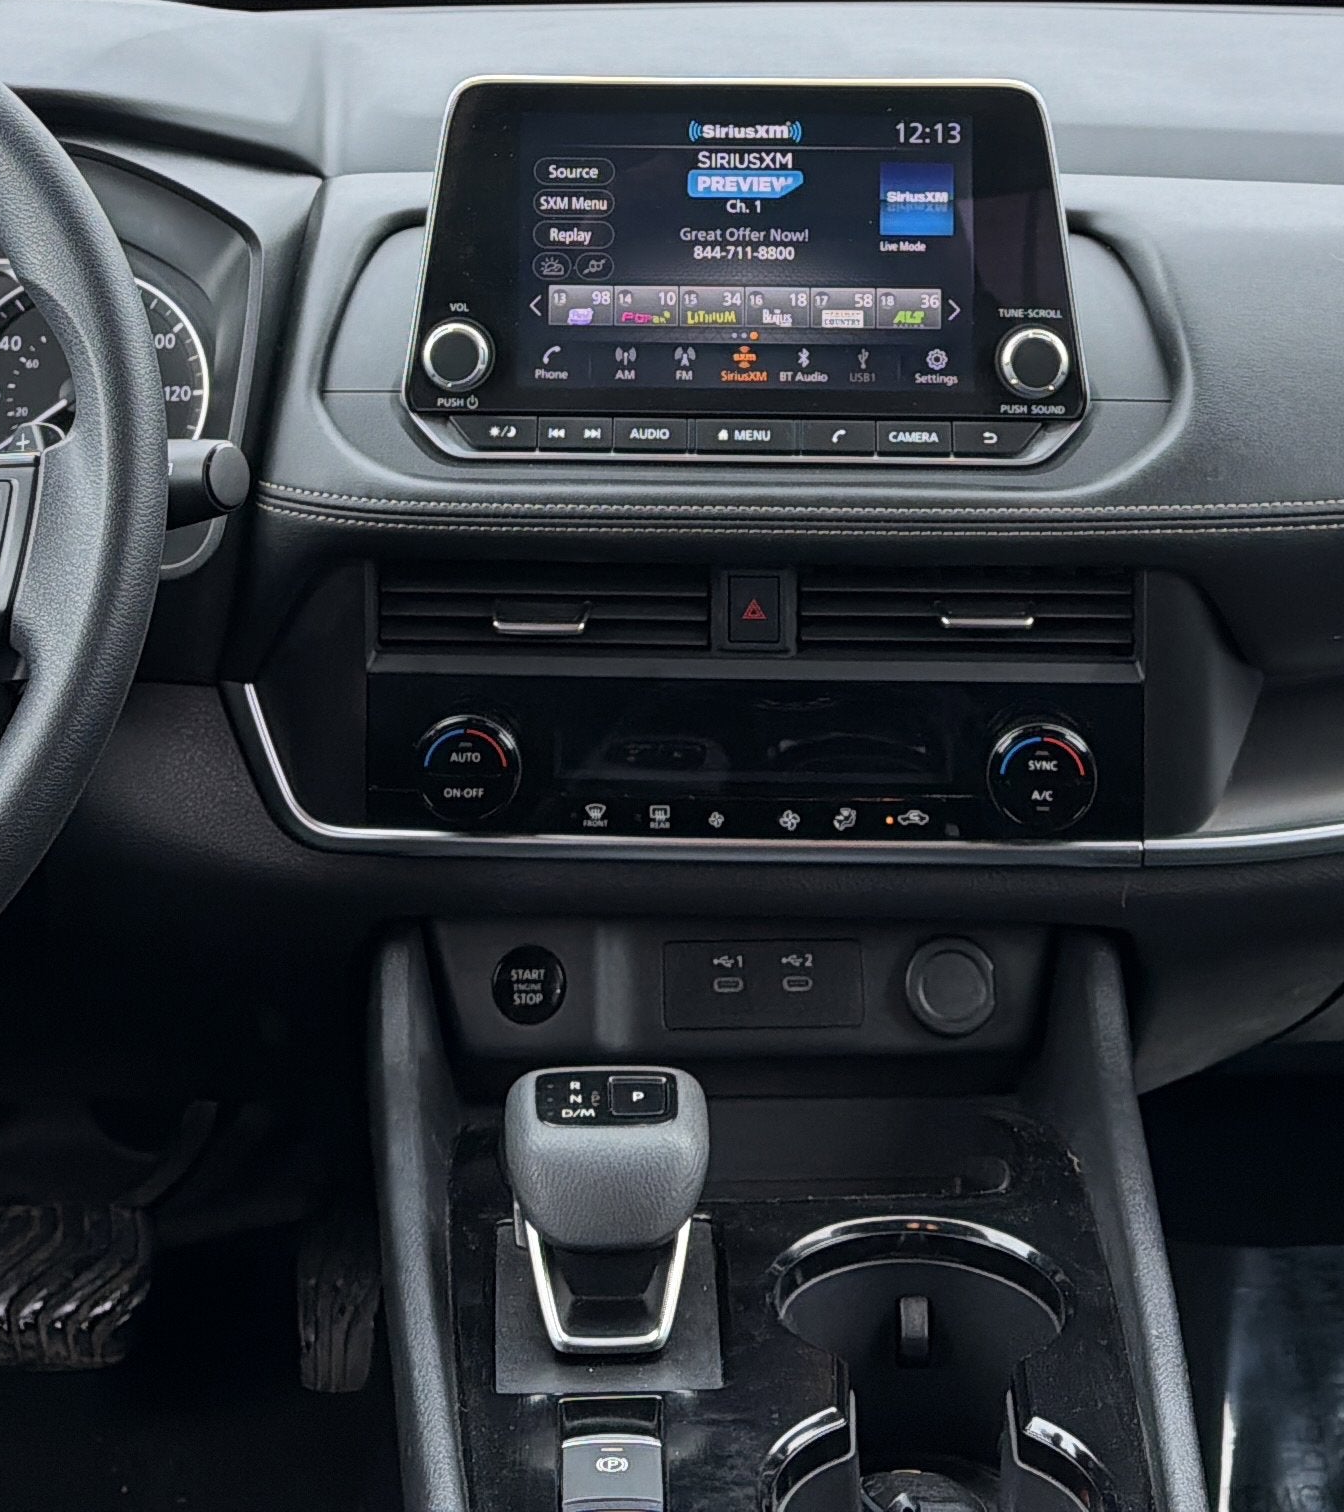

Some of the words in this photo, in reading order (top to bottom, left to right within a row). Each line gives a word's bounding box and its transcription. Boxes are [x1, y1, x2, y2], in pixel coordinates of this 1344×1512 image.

[895, 122, 961, 144] 12:13
[697, 151, 793, 169] SIRIUSXM
[548, 164, 599, 179] Source
[697, 176, 793, 192] PREVIEW
[540, 196, 568, 210] SXM
[571, 196, 608, 211] Menu
[726, 200, 750, 214] Ch.
[755, 200, 761, 213] 1
[549, 227, 592, 245] Replay
[680, 228, 722, 242] Great
[726, 228, 766, 243] Offer
[769, 229, 809, 243] Now!
[693, 246, 795, 261] 844-711-8800
[879, 241, 897, 252] Live
[899, 241, 926, 253] Mode
[553, 292, 567, 304] 13
[591, 291, 611, 305] 98
[618, 293, 632, 305] 14
[658, 291, 676, 306] 10
[684, 293, 698, 305] 15
[722, 291, 742, 306] 34
[749, 294, 763, 306] 16
[789, 292, 807, 307] 18
[814, 294, 828, 306] 17
[855, 293, 873, 308] 58
[880, 295, 894, 307] 18
[920, 294, 940, 308] 36
[449, 302, 469, 312] VOL
[150, 333, 176, 350] 00
[25, 358, 39, 369] 60
[534, 368, 569, 381] Phone
[615, 369, 636, 381] AM
[675, 369, 693, 381] FM
[721, 370, 767, 382] SiriusXM
[780, 371, 793, 382] BT
[795, 371, 828, 383] Audio
[849, 371, 876, 383] USB1
[915, 373, 958, 387] Settings
[437, 397, 464, 407] PUSH
[15, 407, 28, 417] 20
[1000, 404, 1027, 414] PUSH
[1031, 404, 1065, 415] SOUND
[630, 427, 670, 441] AUDIO
[734, 429, 771, 442] MENU
[888, 431, 939, 444] CAMERA
[450, 752, 481, 763] AUTO
[1028, 760, 1058, 772] SYNC
[1031, 790, 1053, 802] A/C
[583, 819, 608, 828] FRONT
[649, 821, 670, 829] REAR
[736, 955, 744, 968] 1
[804, 954, 813, 967] 2
[511, 969, 545, 981] START
[513, 992, 543, 1005] STOP
[569, 1081, 581, 1090] R
[569, 1094, 582, 1104] N
[632, 1091, 644, 1102] P
[561, 1108, 596, 1118] D/M
